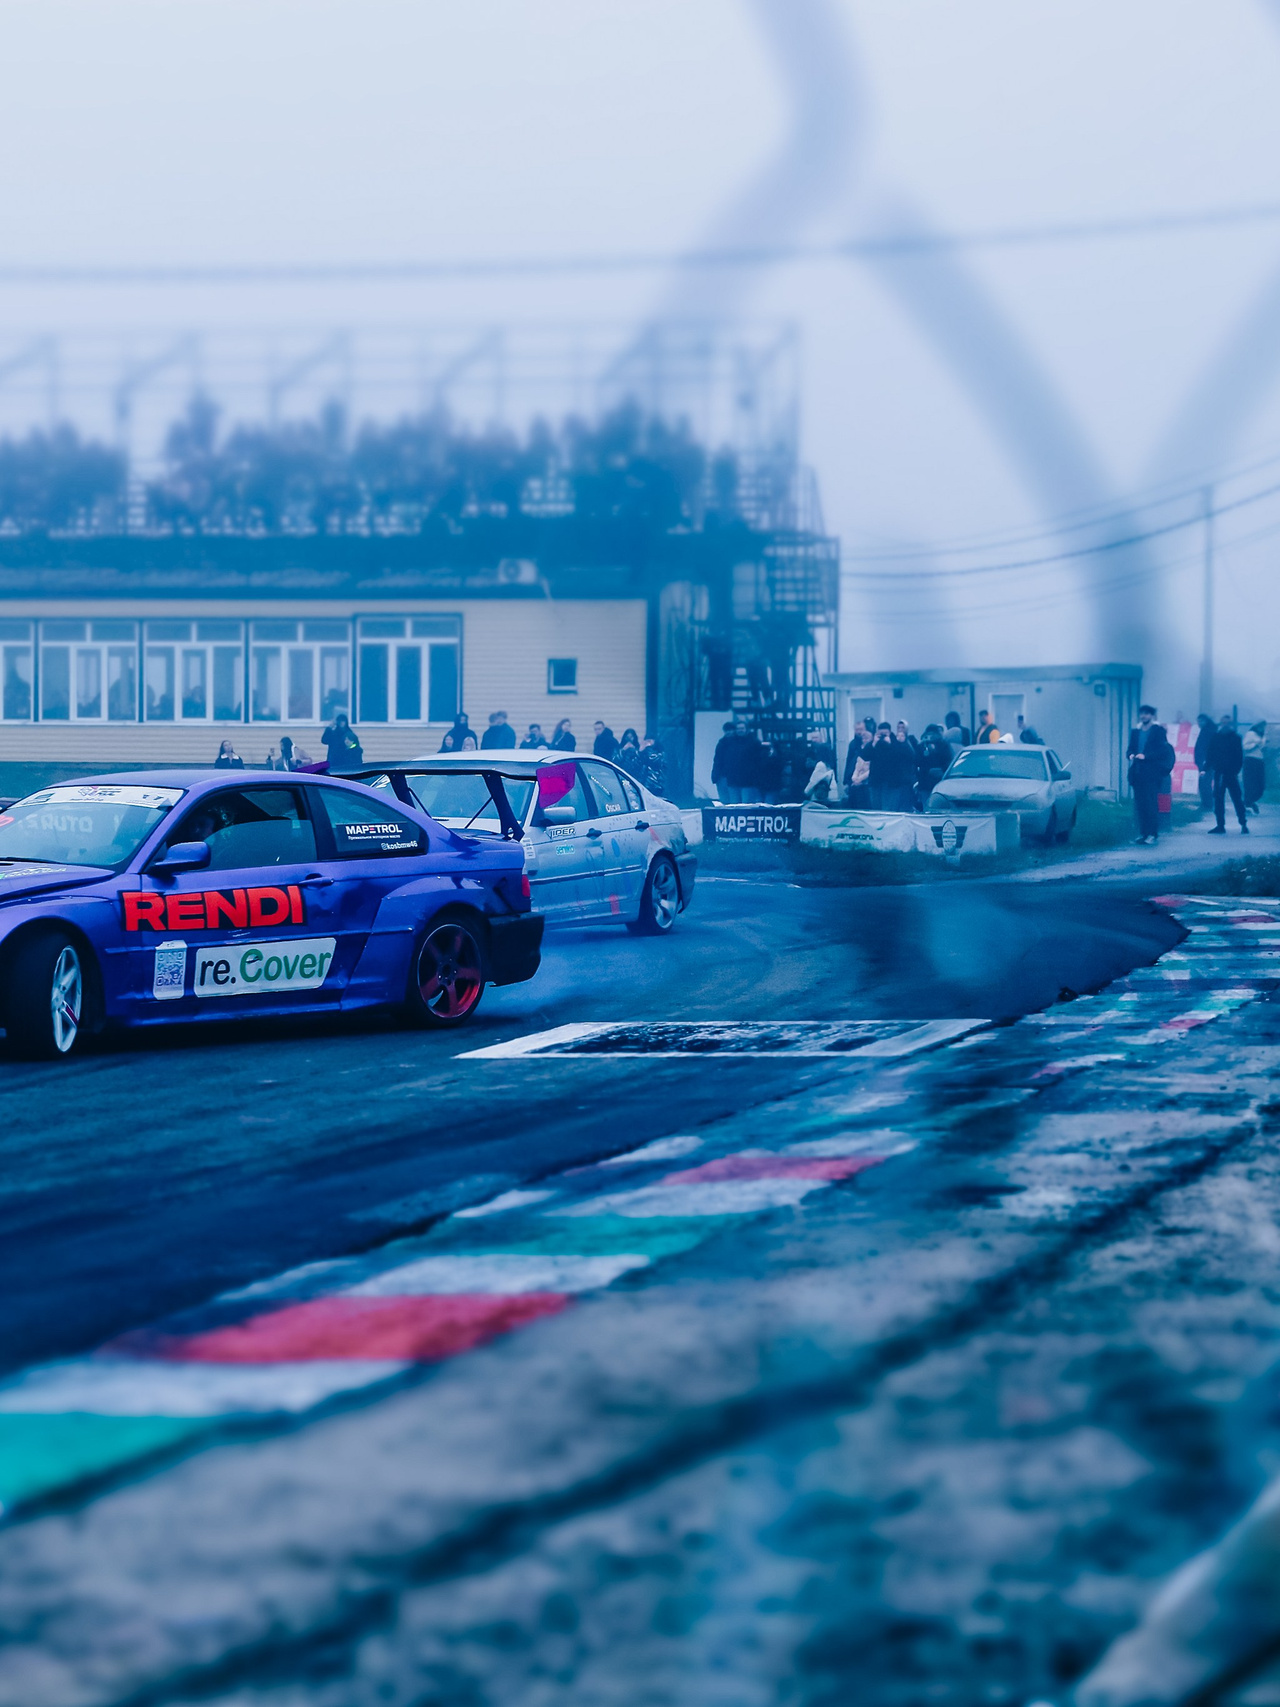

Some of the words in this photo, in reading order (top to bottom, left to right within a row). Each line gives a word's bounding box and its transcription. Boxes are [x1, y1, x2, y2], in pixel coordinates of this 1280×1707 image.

[345, 824, 402, 835] MAPETROL
[715, 816, 793, 832] MAPETROL
[122, 885, 304, 931] RENDI
[200, 948, 332, 986] re.Cover
